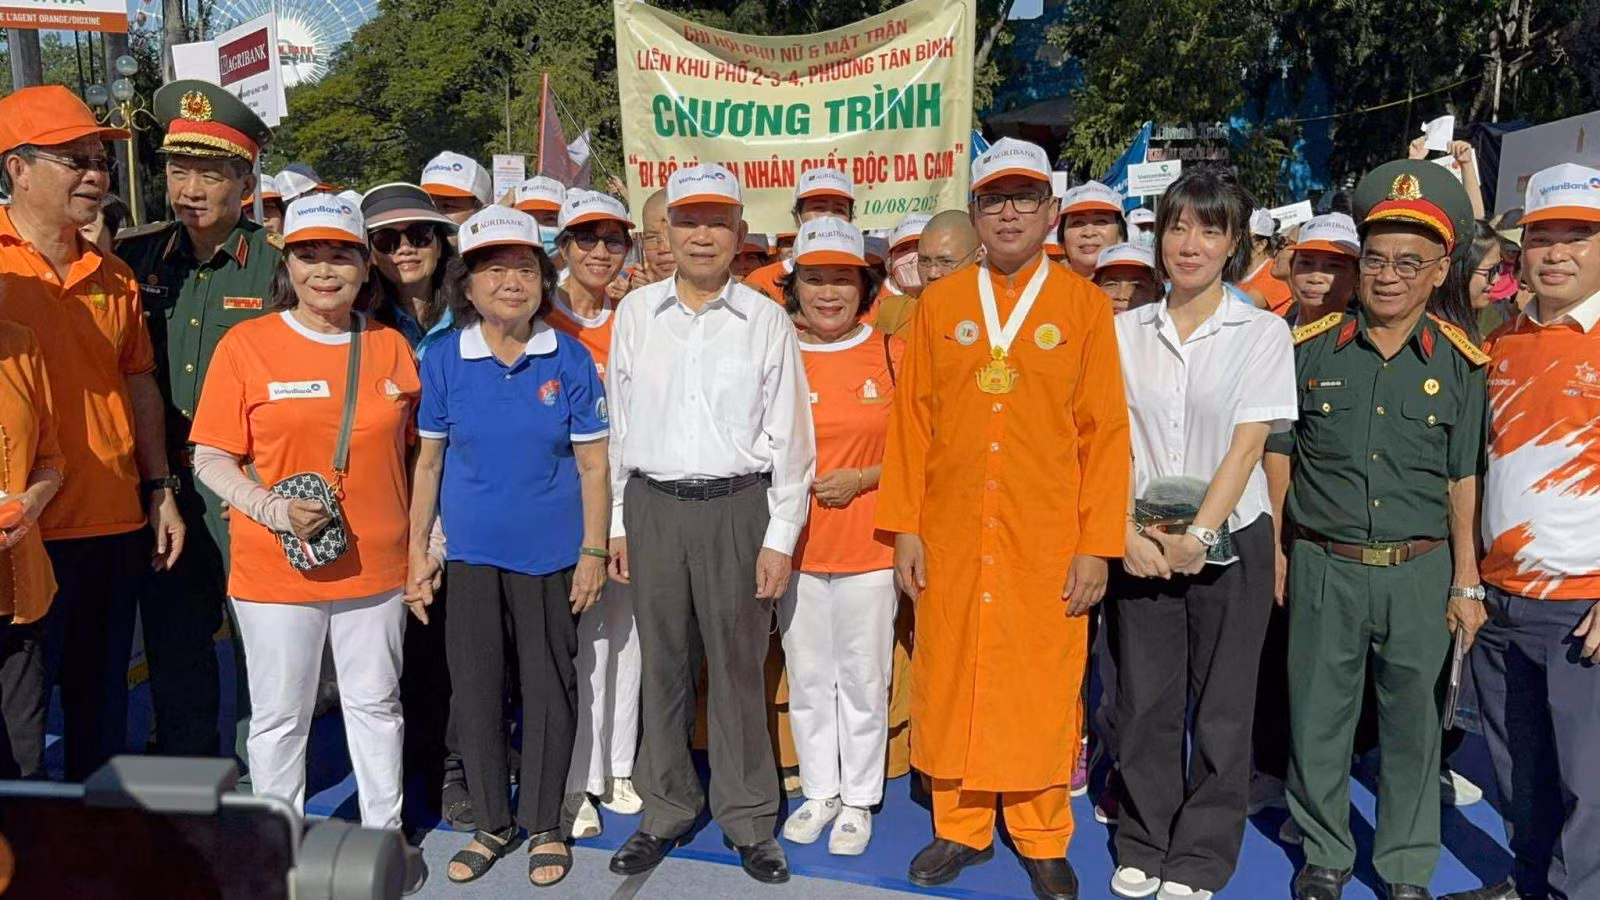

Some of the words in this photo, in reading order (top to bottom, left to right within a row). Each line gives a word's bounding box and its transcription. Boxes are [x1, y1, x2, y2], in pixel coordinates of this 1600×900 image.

[6, 12, 37, 22] L'AGENT
[39, 14, 101, 25] ORANGE/DIOXINE
[228, 44, 267, 71] AGRIBANK
[780, 43, 804, 63] NỮ
[809, 45, 820, 59] &
[824, 34, 860, 55] MẶT
[638, 47, 671, 72] LIÊN
[676, 55, 710, 79] KHU
[715, 59, 750, 83] PHỐ
[808, 56, 874, 84] PHƯỜNG
[878, 48, 911, 70] TÂN
[916, 36, 954, 62] BÌNH
[652, 94, 811, 138] CHƯƠNG
[824, 83, 942, 133] TRÌNH
[992, 149, 1036, 161] AGRIBANK
[744, 154, 795, 189] NHÂN
[852, 150, 889, 190] ĐỘC
[894, 153, 919, 182] DA
[297, 205, 342, 216] VietinBank
[480, 219, 524, 229] AGRIBANK
[817, 230, 856, 241] AGRIBANK
